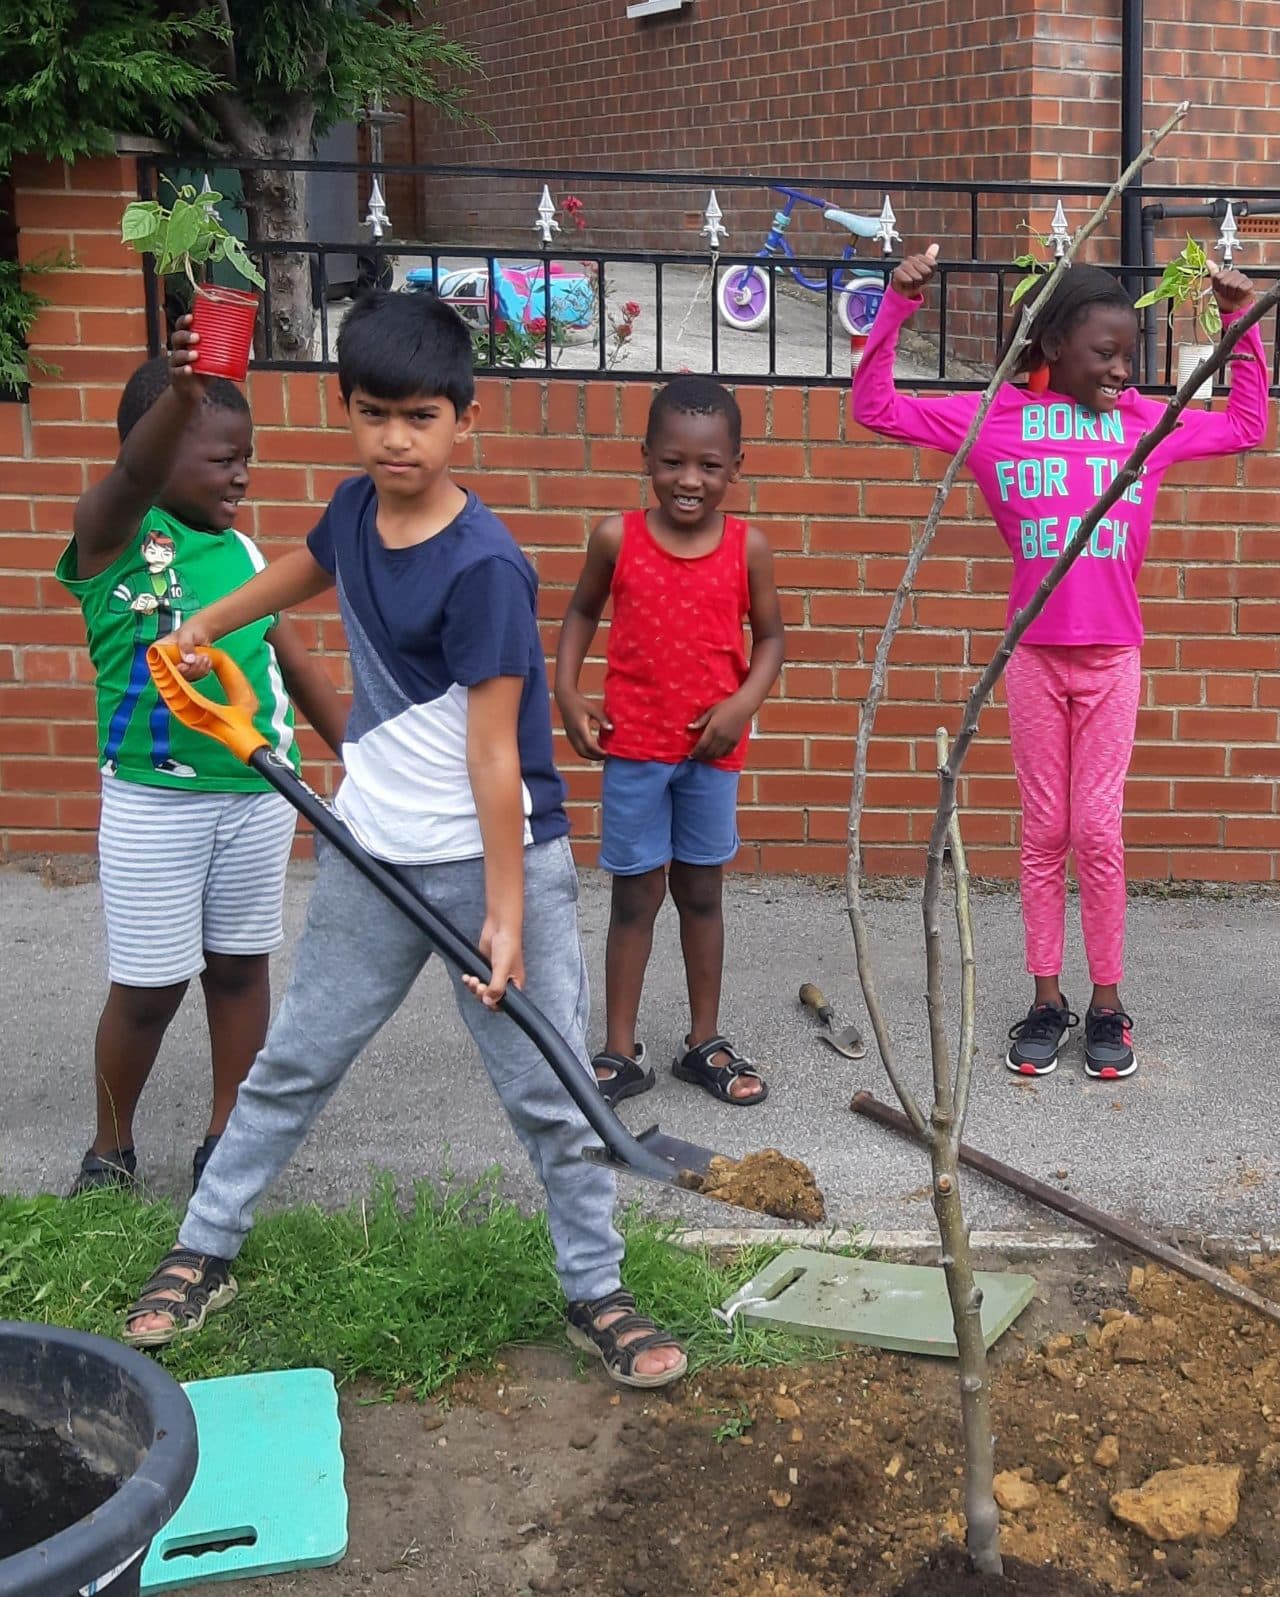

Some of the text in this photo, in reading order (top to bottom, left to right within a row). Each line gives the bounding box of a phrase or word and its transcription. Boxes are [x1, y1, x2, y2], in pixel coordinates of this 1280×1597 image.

[1021, 402, 1125, 444] BORN
[994, 457, 1069, 502] FOR
[170, 586, 182, 598] 10
